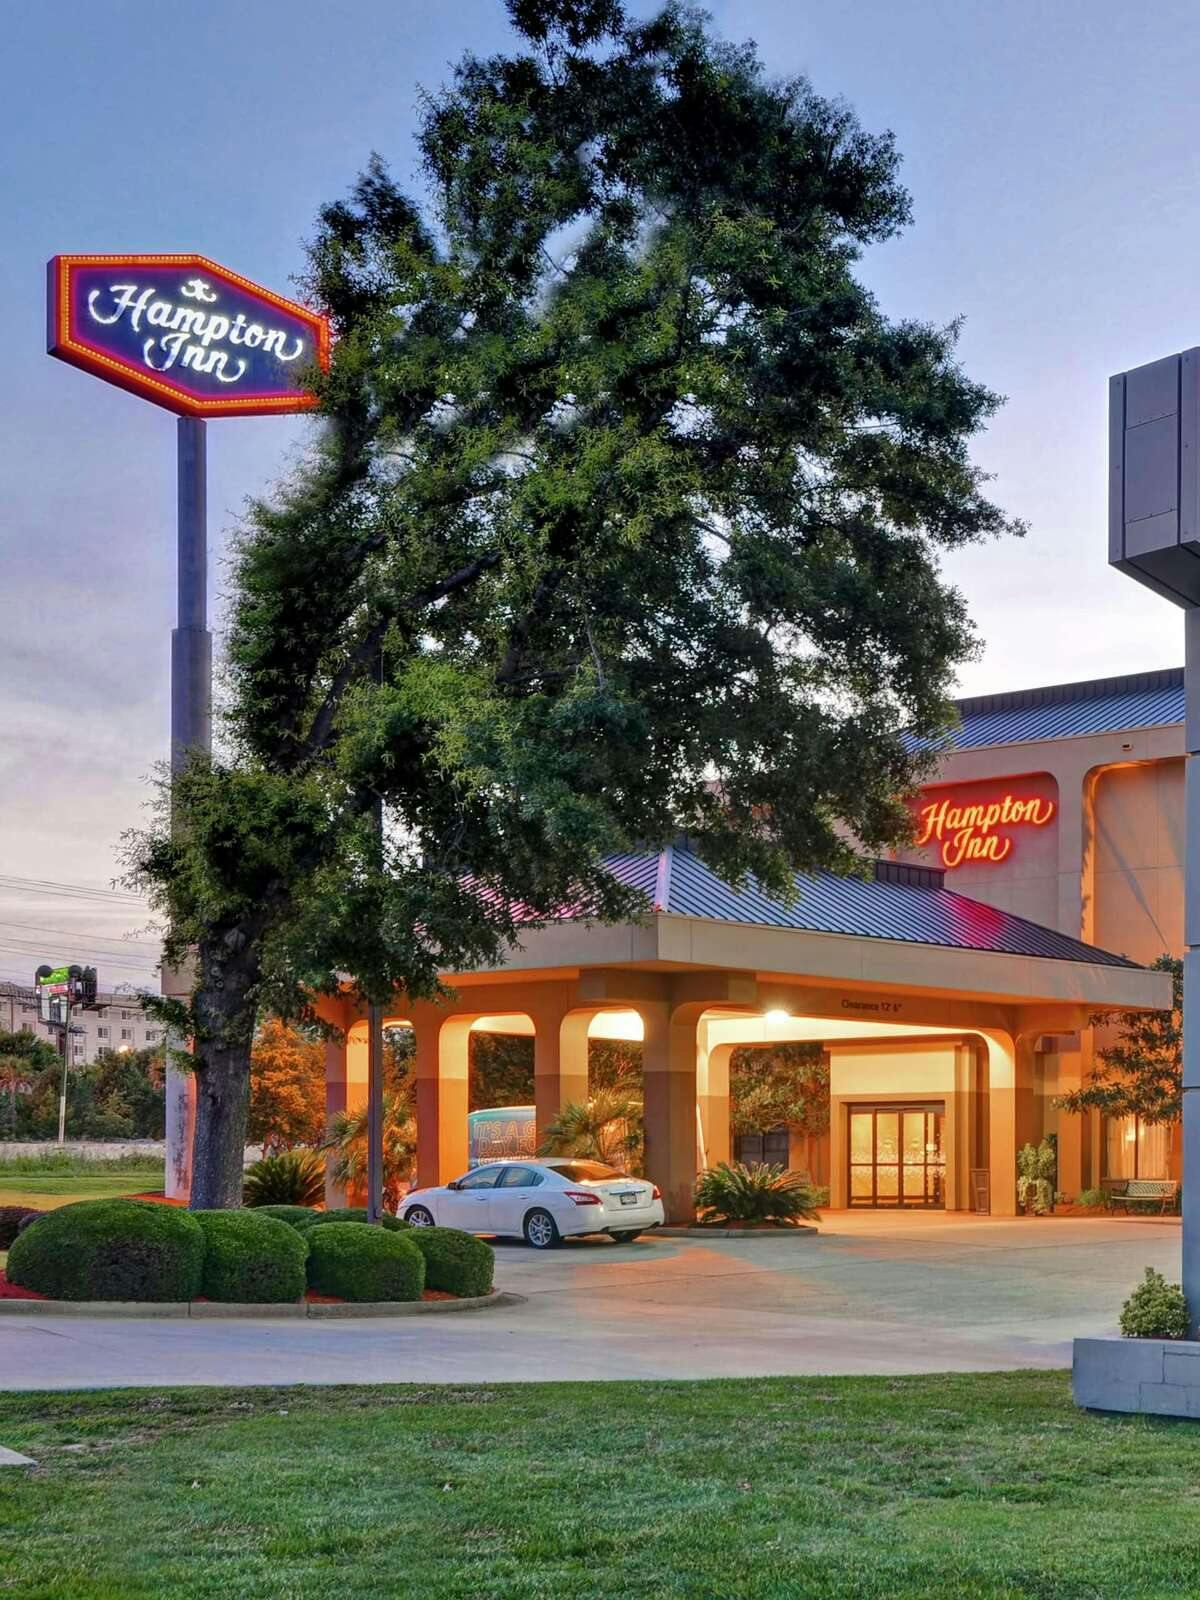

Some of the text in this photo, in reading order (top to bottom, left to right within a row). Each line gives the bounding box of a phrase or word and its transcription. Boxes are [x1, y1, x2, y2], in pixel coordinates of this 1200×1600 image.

[88, 284, 303, 361] Hampton
[143, 333, 246, 382] Inn
[913, 795, 1053, 845] Hampton
[942, 827, 1010, 867] Inn
[841, 999, 879, 1011] Clearance
